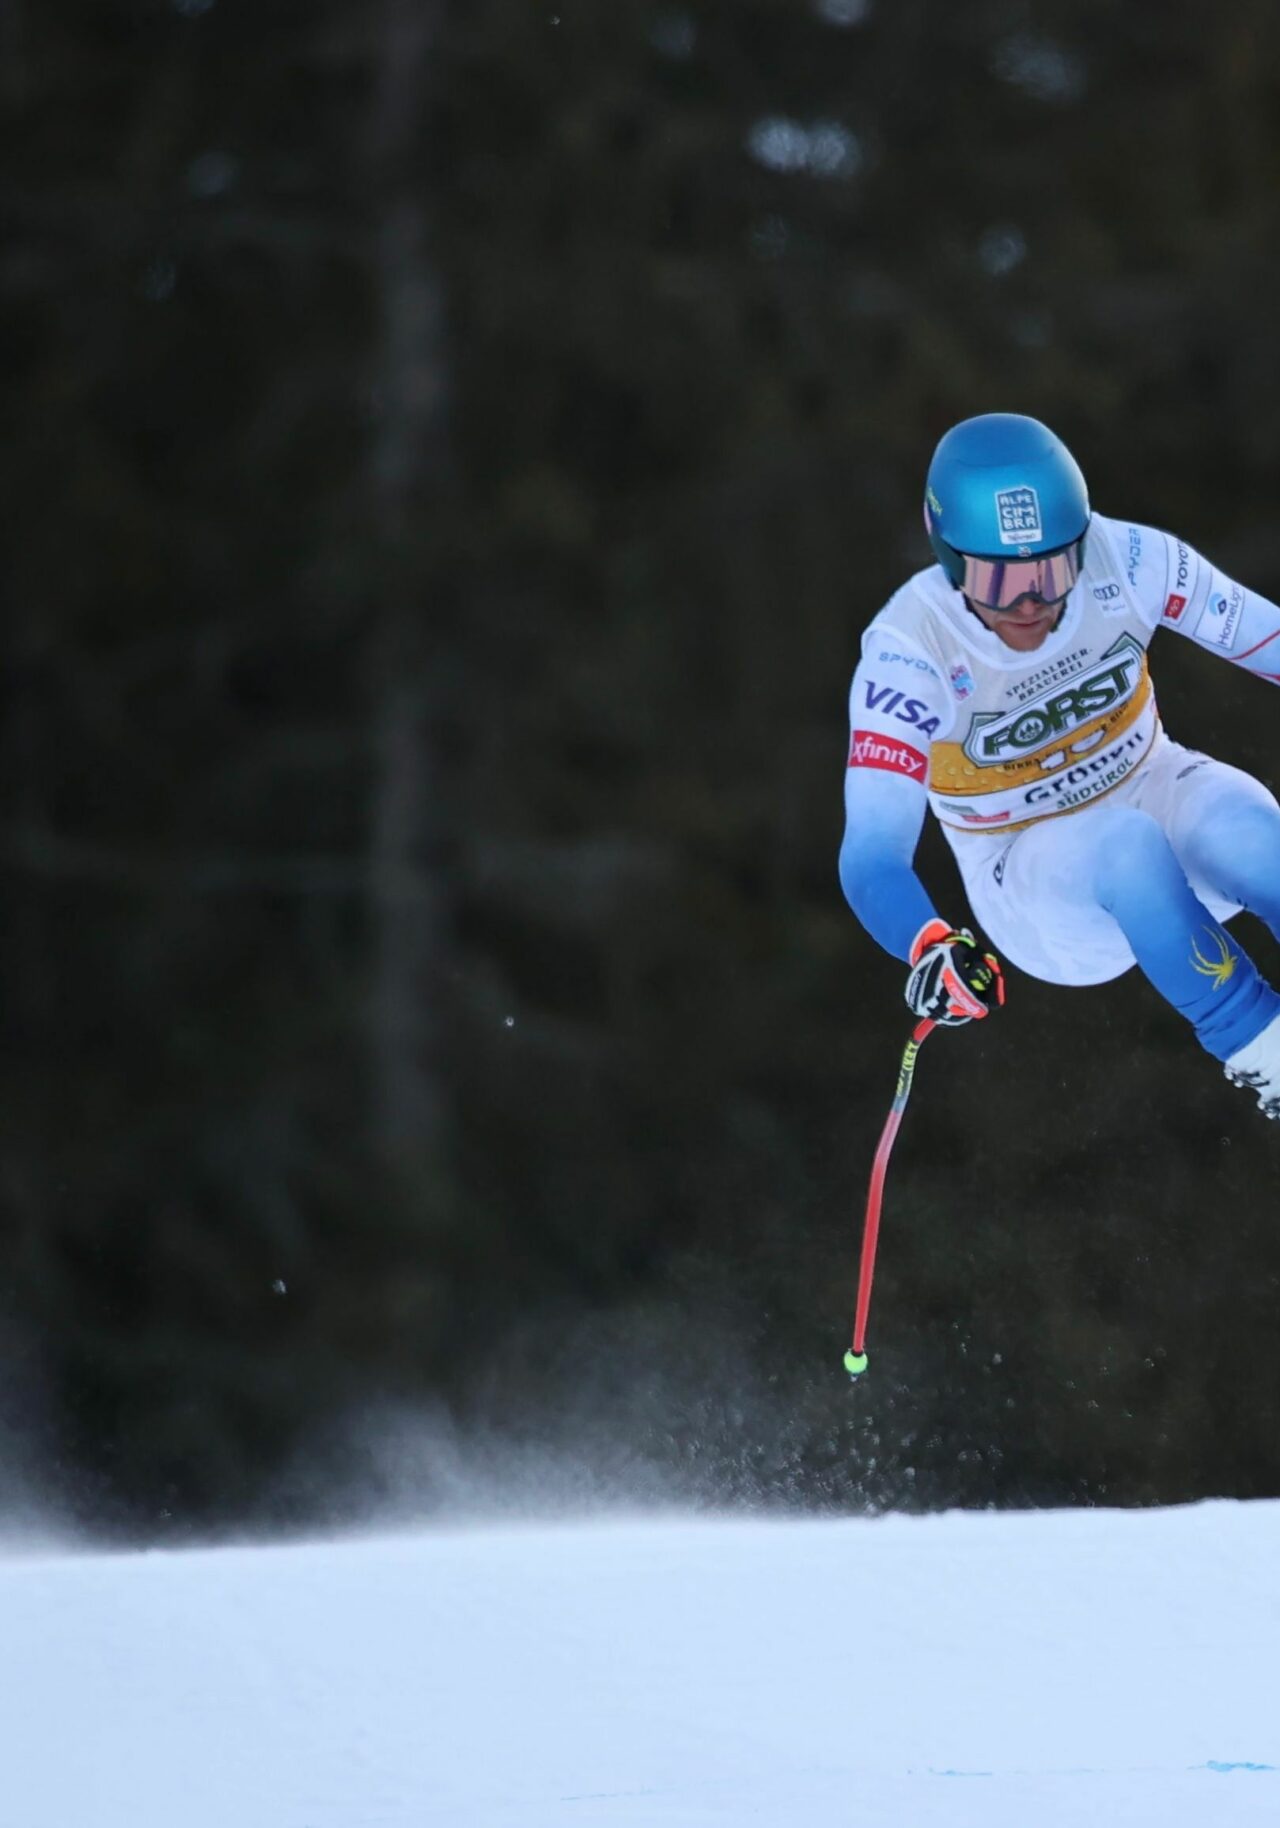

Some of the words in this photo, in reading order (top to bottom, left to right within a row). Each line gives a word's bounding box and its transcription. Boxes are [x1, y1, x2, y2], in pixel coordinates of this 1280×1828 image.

[1018, 661, 1084, 702] BRAUEREI
[864, 680, 941, 740] VISA
[983, 657, 1136, 757] FORST
[852, 736, 923, 774] xfinity
